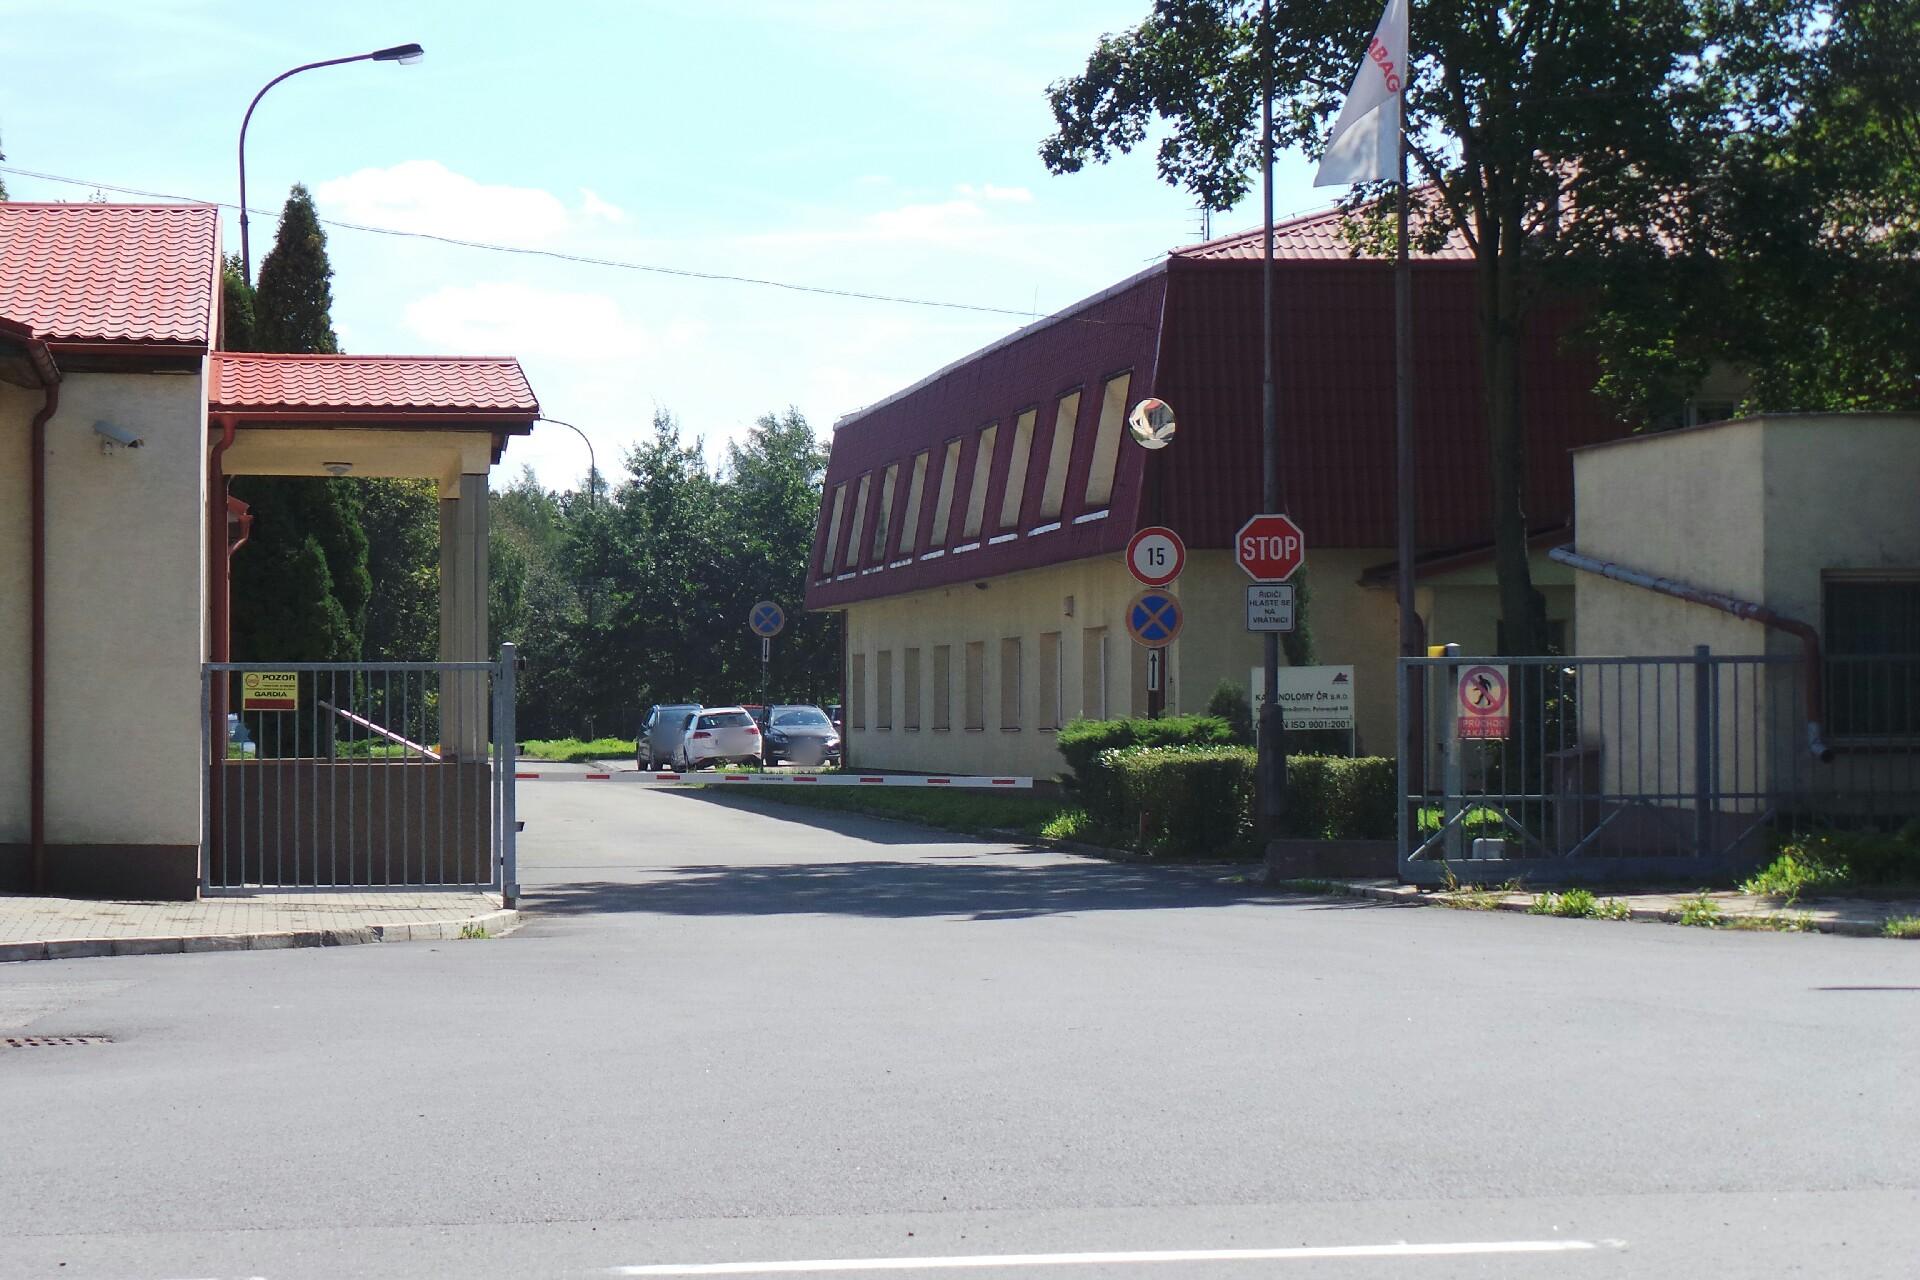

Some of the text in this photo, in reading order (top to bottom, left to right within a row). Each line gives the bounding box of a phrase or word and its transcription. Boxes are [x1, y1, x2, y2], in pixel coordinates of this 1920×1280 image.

[1242, 535, 1298, 561] STOP
[1147, 547, 1165, 566] 15
[1255, 693, 1313, 701] KANOLOMY
[1316, 690, 1329, 700] ČR
[1291, 720, 1306, 729] ISO
[1308, 720, 1350, 729] 9001:2001
